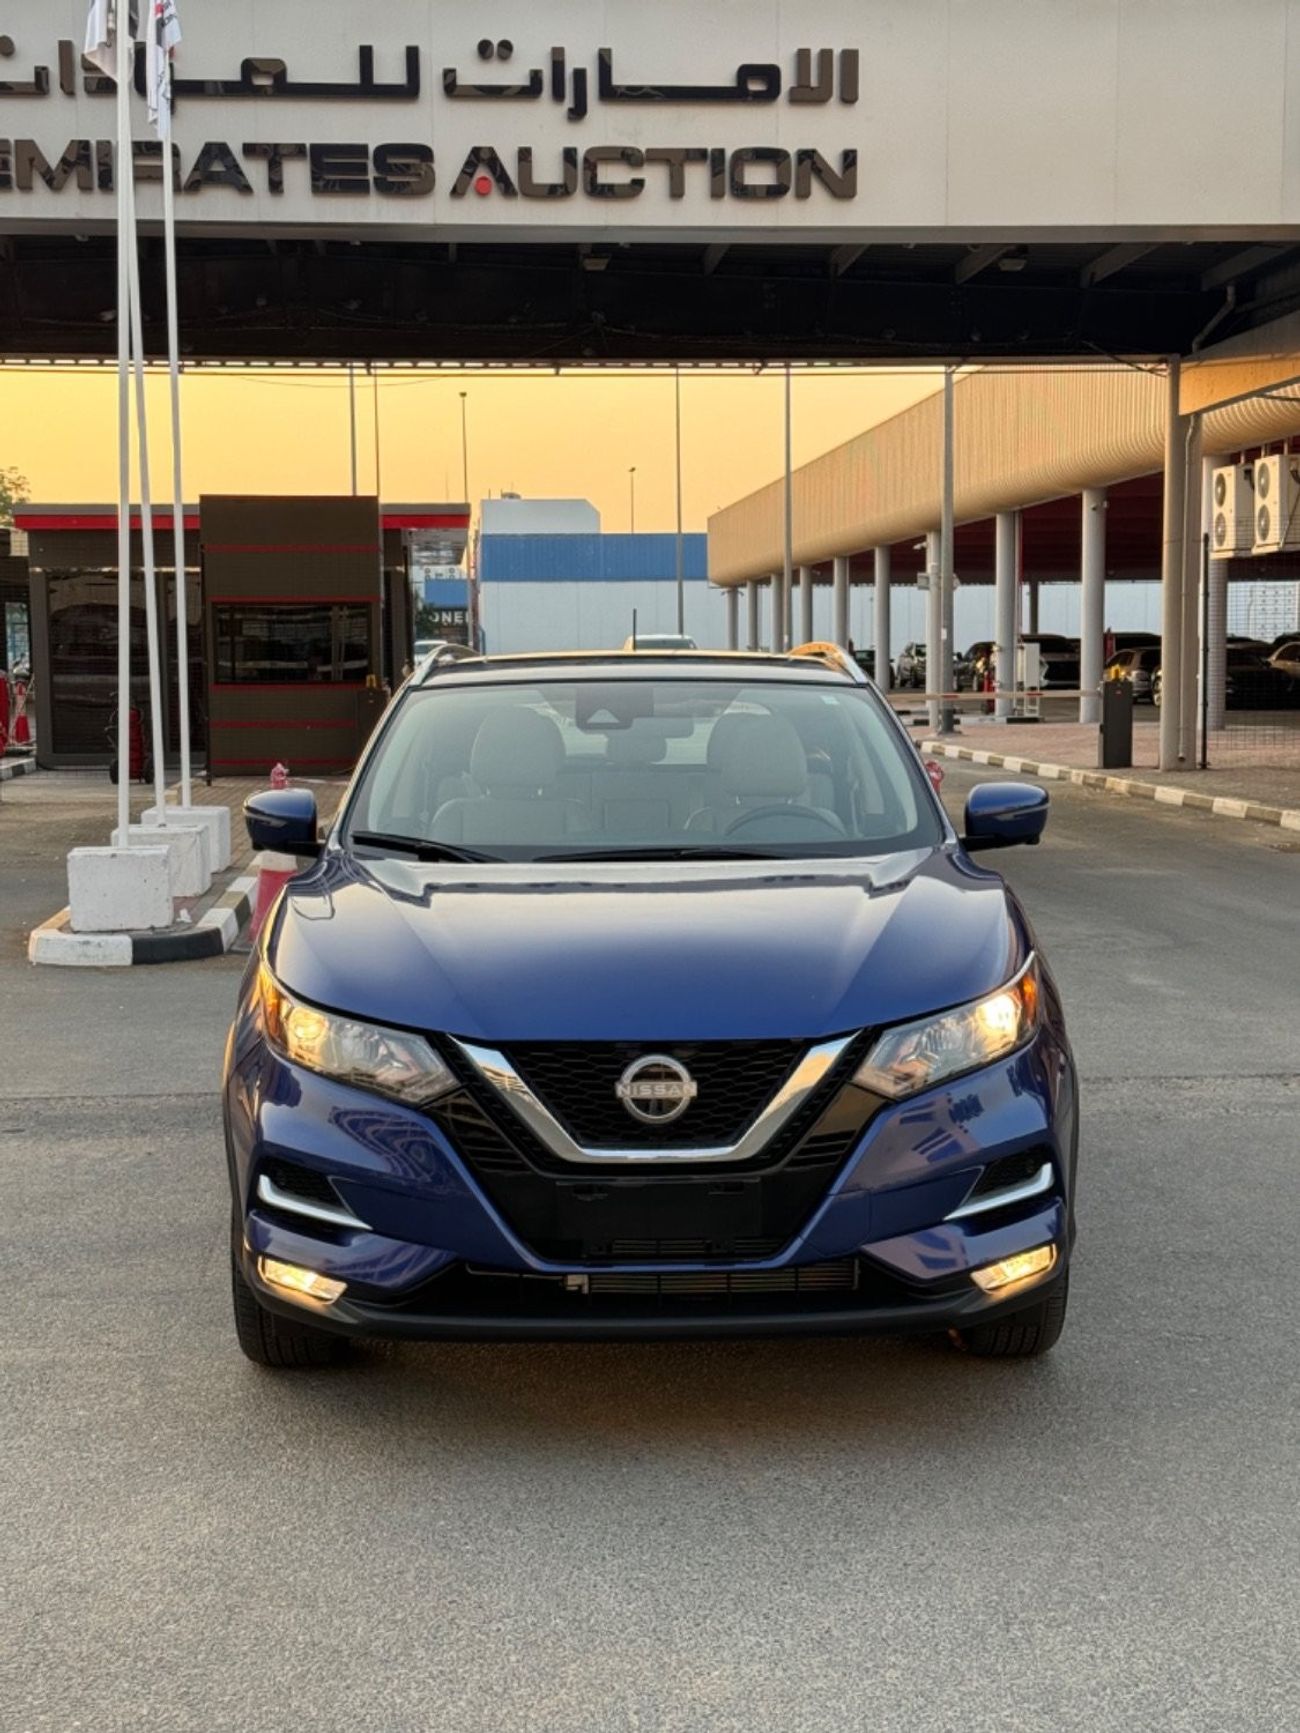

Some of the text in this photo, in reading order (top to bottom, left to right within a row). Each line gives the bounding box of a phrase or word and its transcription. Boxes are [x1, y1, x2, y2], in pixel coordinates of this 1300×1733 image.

[0, 138, 858, 199] MIRATES AUCTION
[617, 1083, 696, 1098] NISSAN
